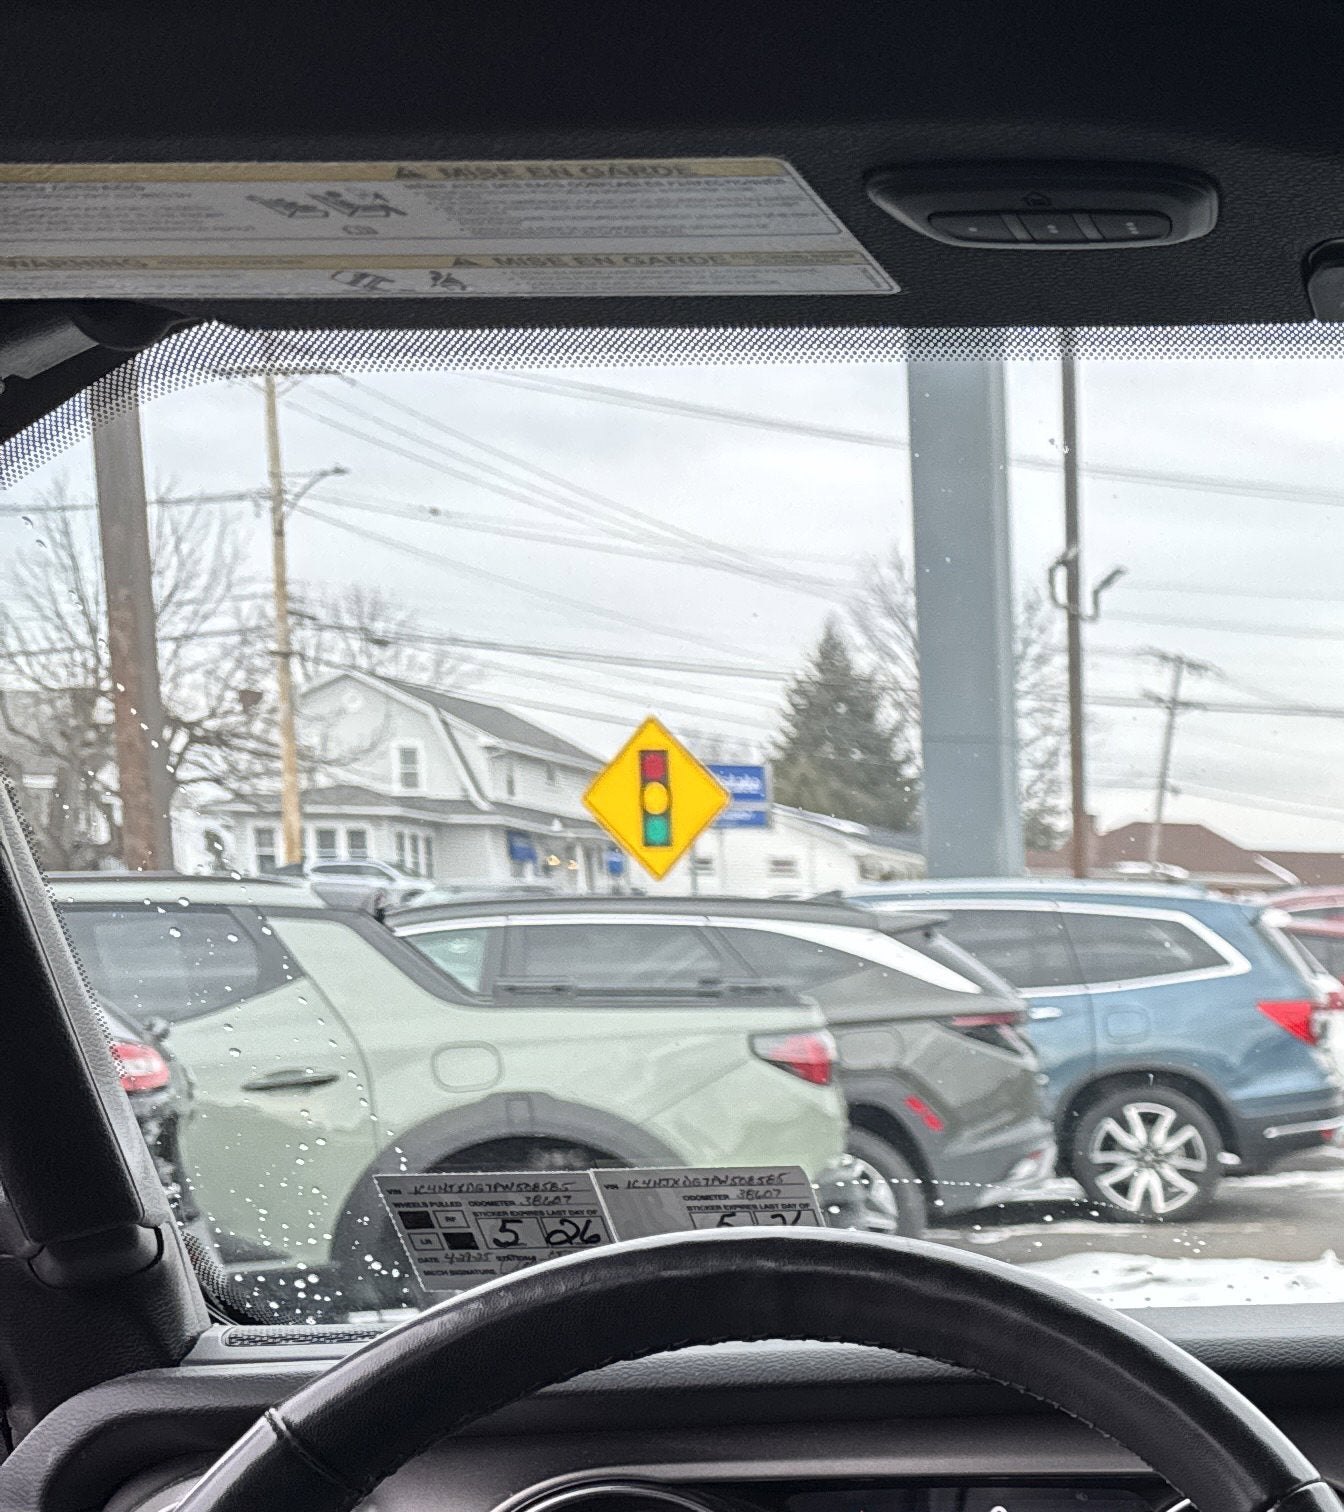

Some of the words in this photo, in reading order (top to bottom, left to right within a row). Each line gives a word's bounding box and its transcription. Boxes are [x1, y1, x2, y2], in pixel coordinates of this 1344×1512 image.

[440, 165, 515, 179] MISE
[528, 165, 575, 179] EN
[580, 163, 692, 178] GARDE
[492, 254, 564, 267] MISE
[584, 254, 621, 267] EN
[633, 253, 721, 266] GARDE
[468, 1200, 516, 1208] ODOMETER
[493, 1219, 523, 1247] 5
[545, 1218, 601, 1246] 26
